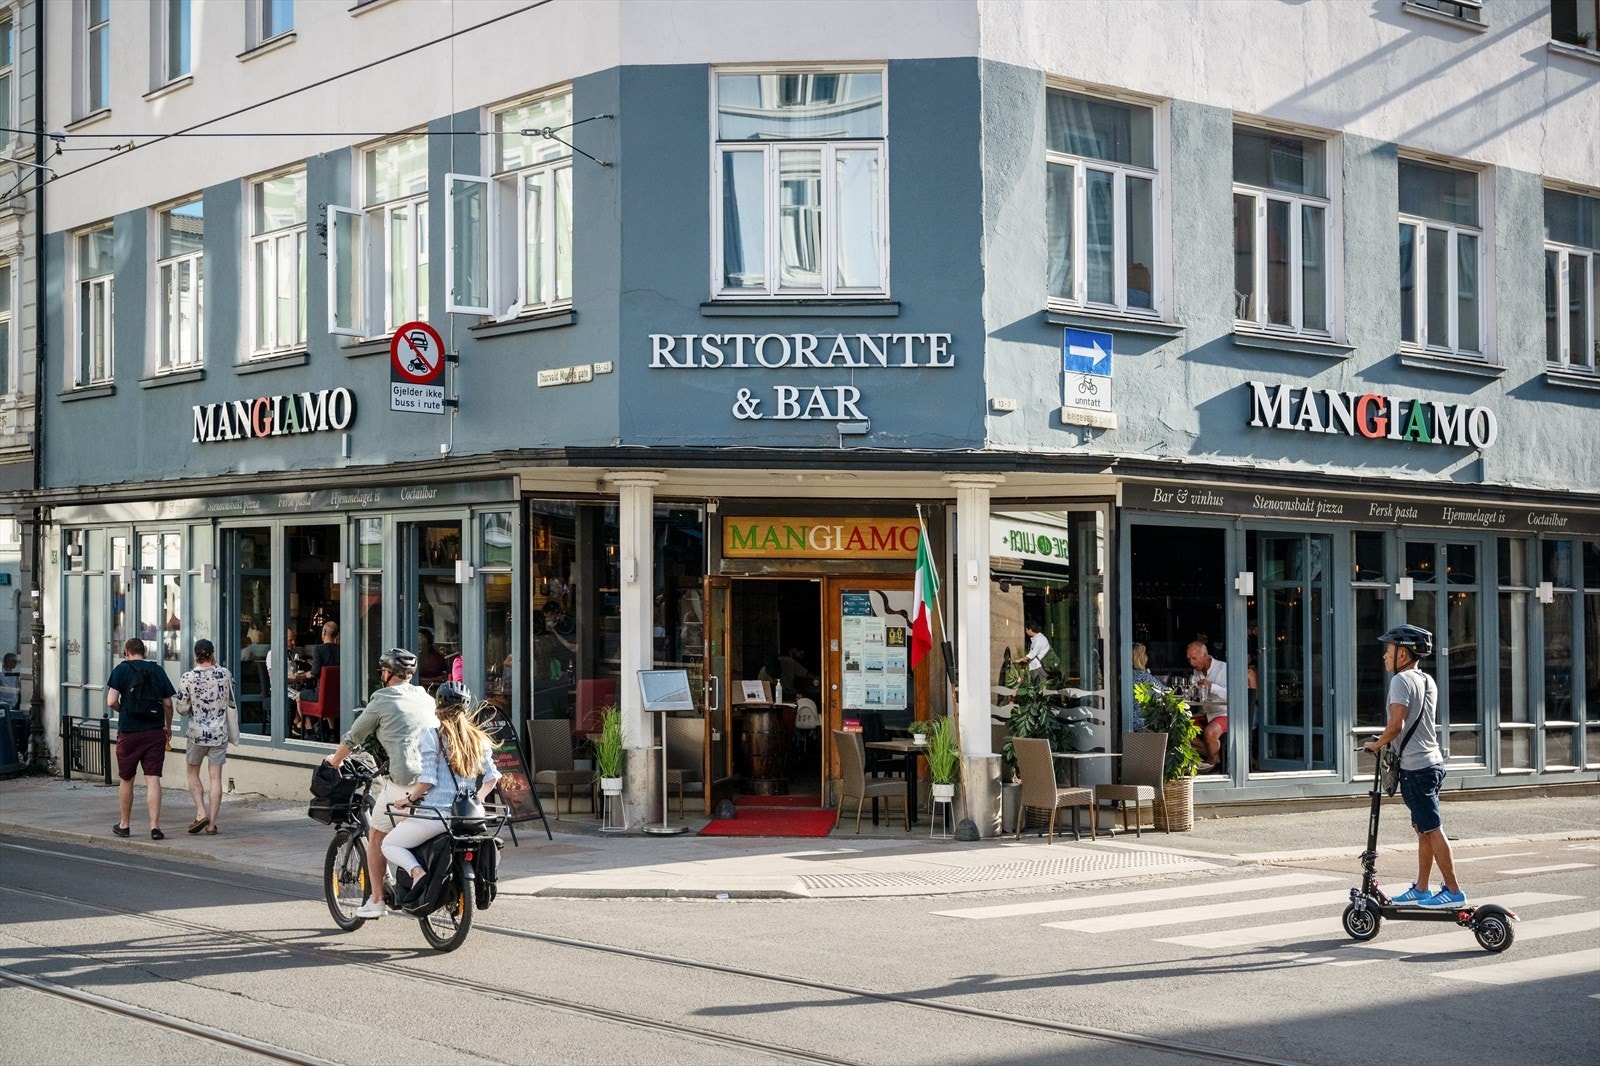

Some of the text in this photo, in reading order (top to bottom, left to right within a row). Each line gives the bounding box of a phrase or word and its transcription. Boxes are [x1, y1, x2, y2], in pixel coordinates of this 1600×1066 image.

[649, 333, 955, 368] RISTORANTE
[393, 386, 443, 399] Gjelder ikke
[732, 385, 869, 420] & BAR
[1074, 397, 1101, 408] unntatt
[395, 398, 441, 410] buss i rute
[192, 387, 354, 443] MANGIAMO
[1250, 381, 1498, 449] MANGIAMO
[331, 489, 381, 509] Hjemmelaget is
[400, 484, 438, 500] Coctailbar
[1152, 487, 1225, 506] Bar & vinhus
[1252, 494, 1344, 517] Stenovnsbakt pizza
[1368, 502, 1419, 522] Fersk pasta
[1441, 506, 1506, 526] Hjemmelaget is
[1526, 511, 1569, 527] Coctailbar
[729, 525, 922, 551] MANGIAMO
